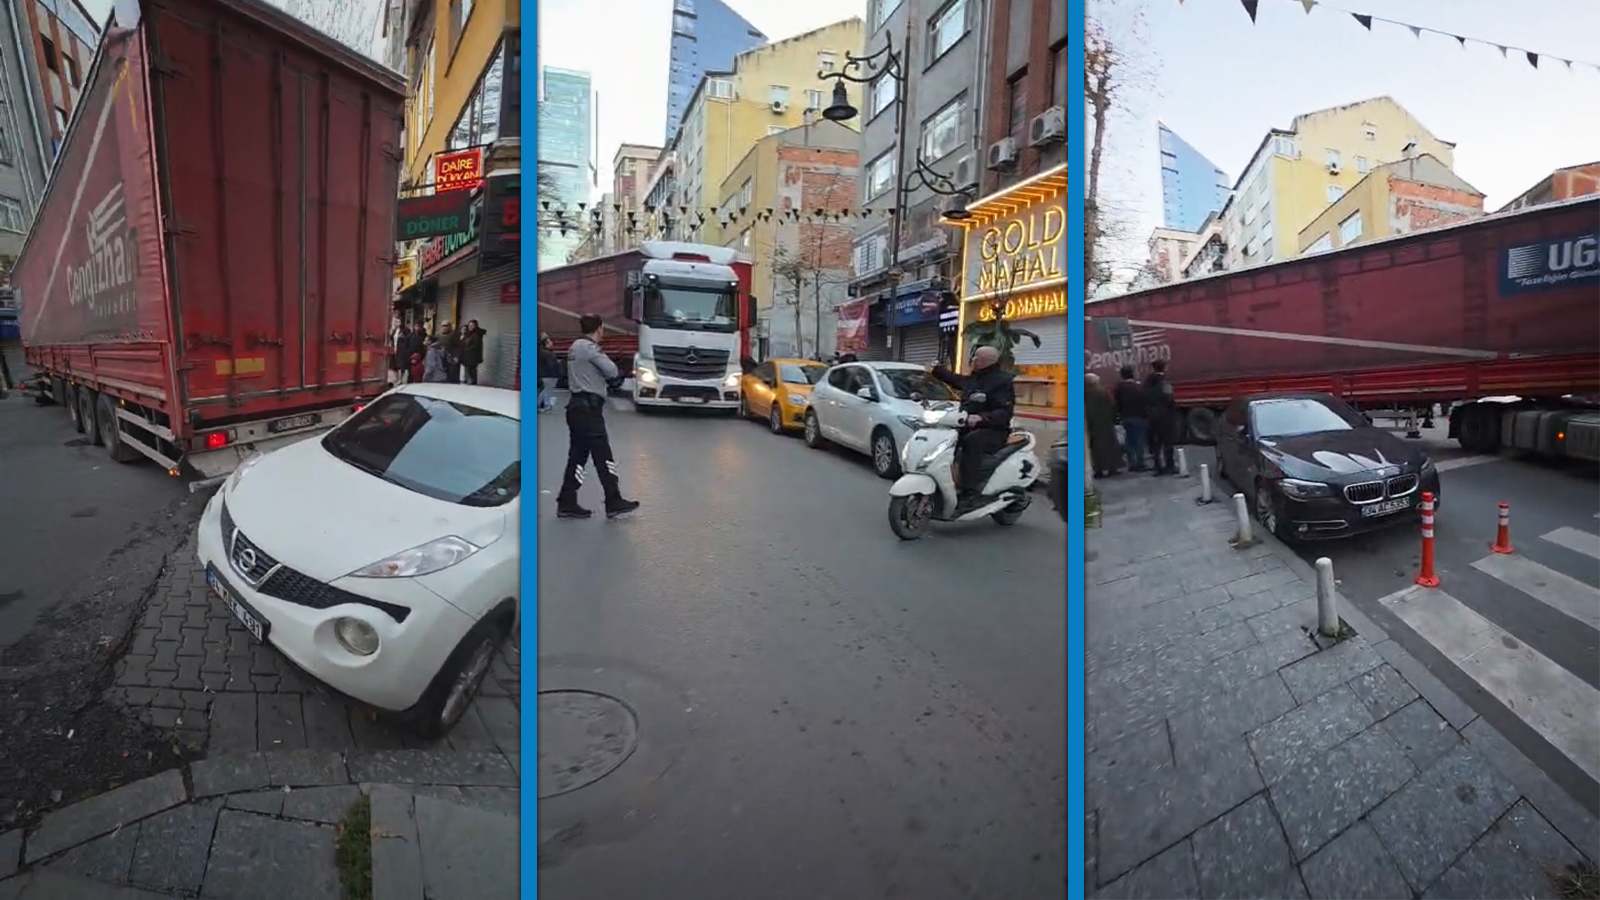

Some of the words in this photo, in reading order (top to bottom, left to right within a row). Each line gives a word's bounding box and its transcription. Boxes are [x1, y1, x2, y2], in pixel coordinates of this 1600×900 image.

[406, 215, 459, 235] DÖNER
[980, 205, 1067, 262] GOLD
[979, 247, 1062, 290] MAHAL
[1017, 291, 1067, 316] MAHAL
